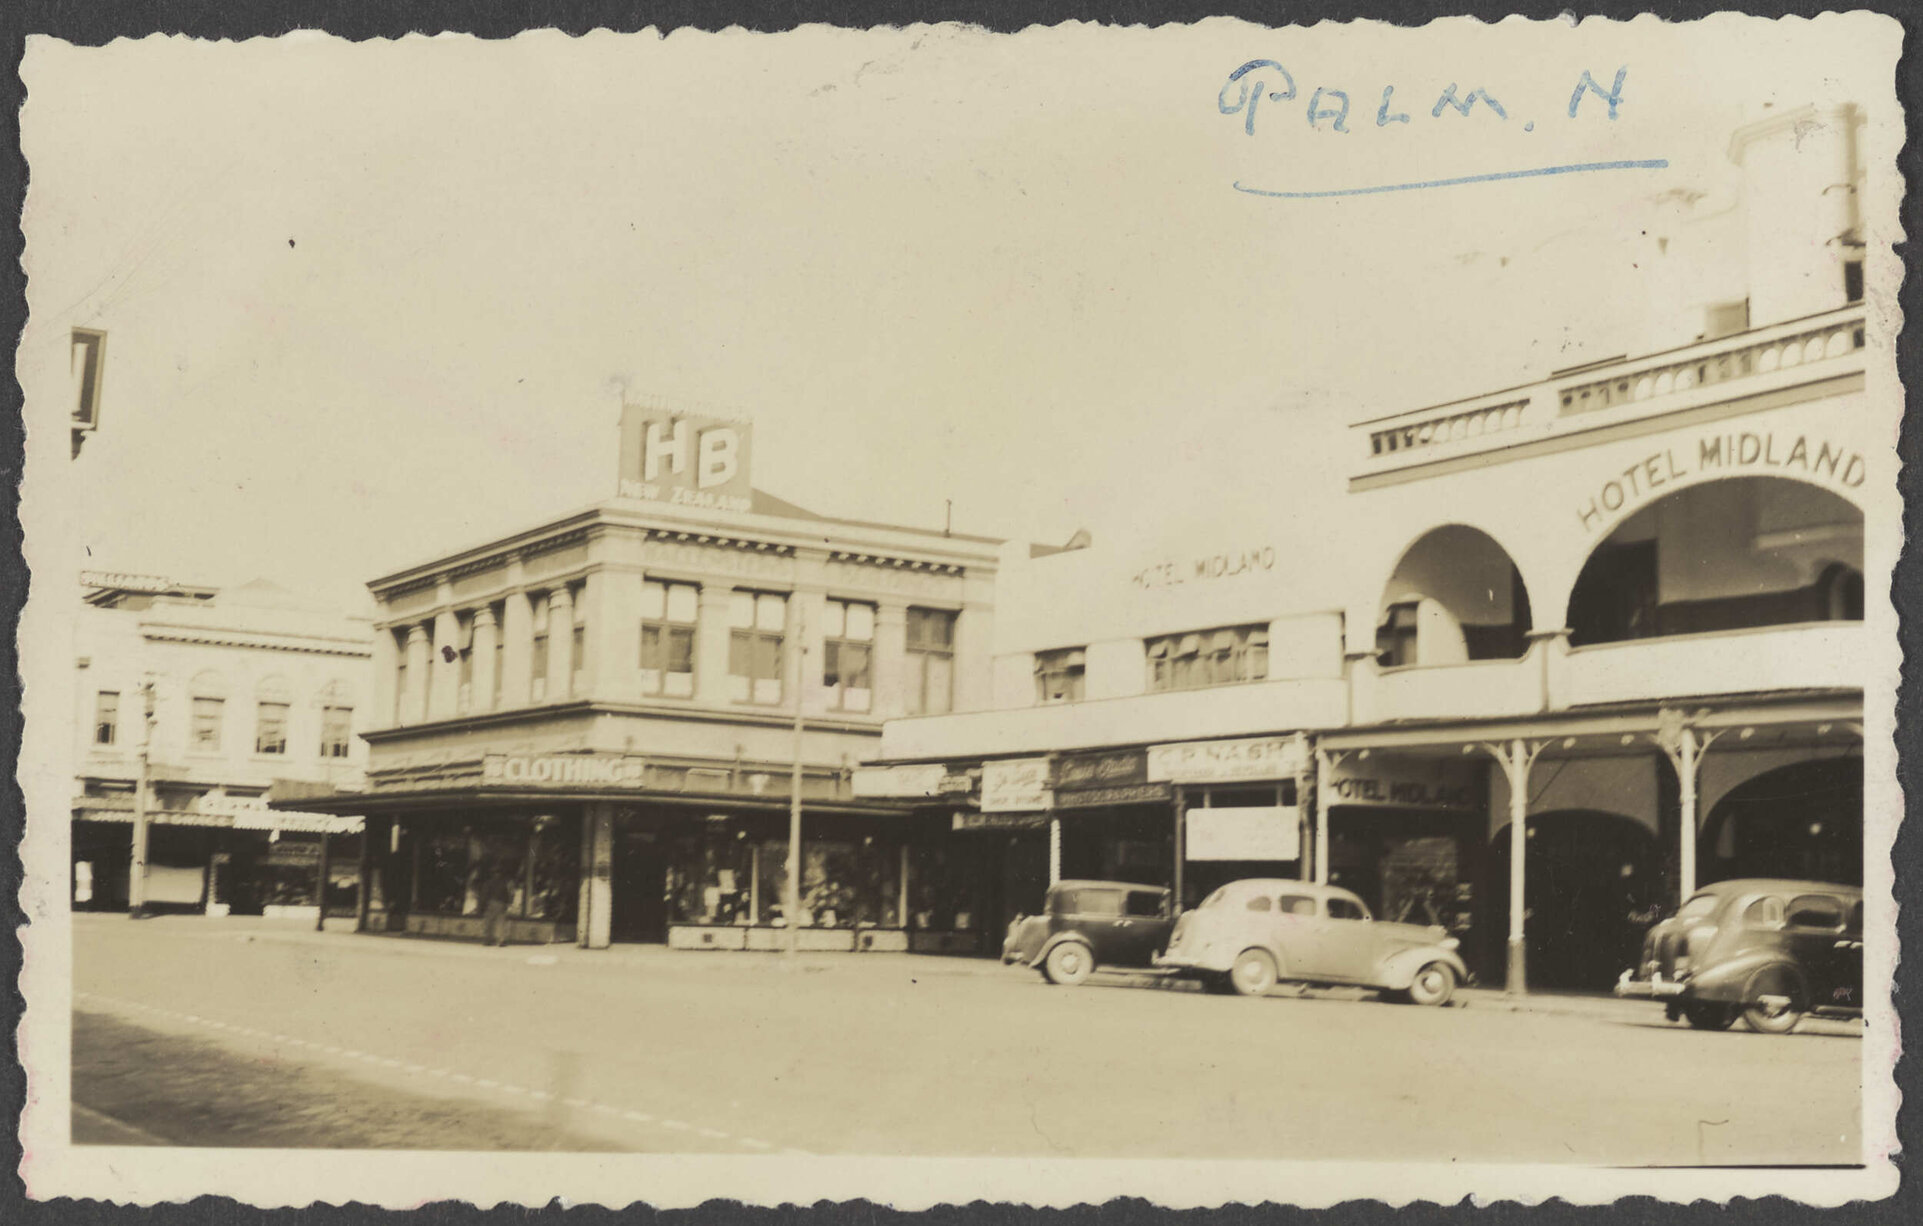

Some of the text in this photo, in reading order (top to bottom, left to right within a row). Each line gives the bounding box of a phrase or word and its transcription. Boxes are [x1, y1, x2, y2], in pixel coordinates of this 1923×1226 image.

[1569, 66, 1628, 120] N
[1577, 432, 1866, 532] HOTEL MIDLAND
[503, 757, 623, 783] CLOTHING
